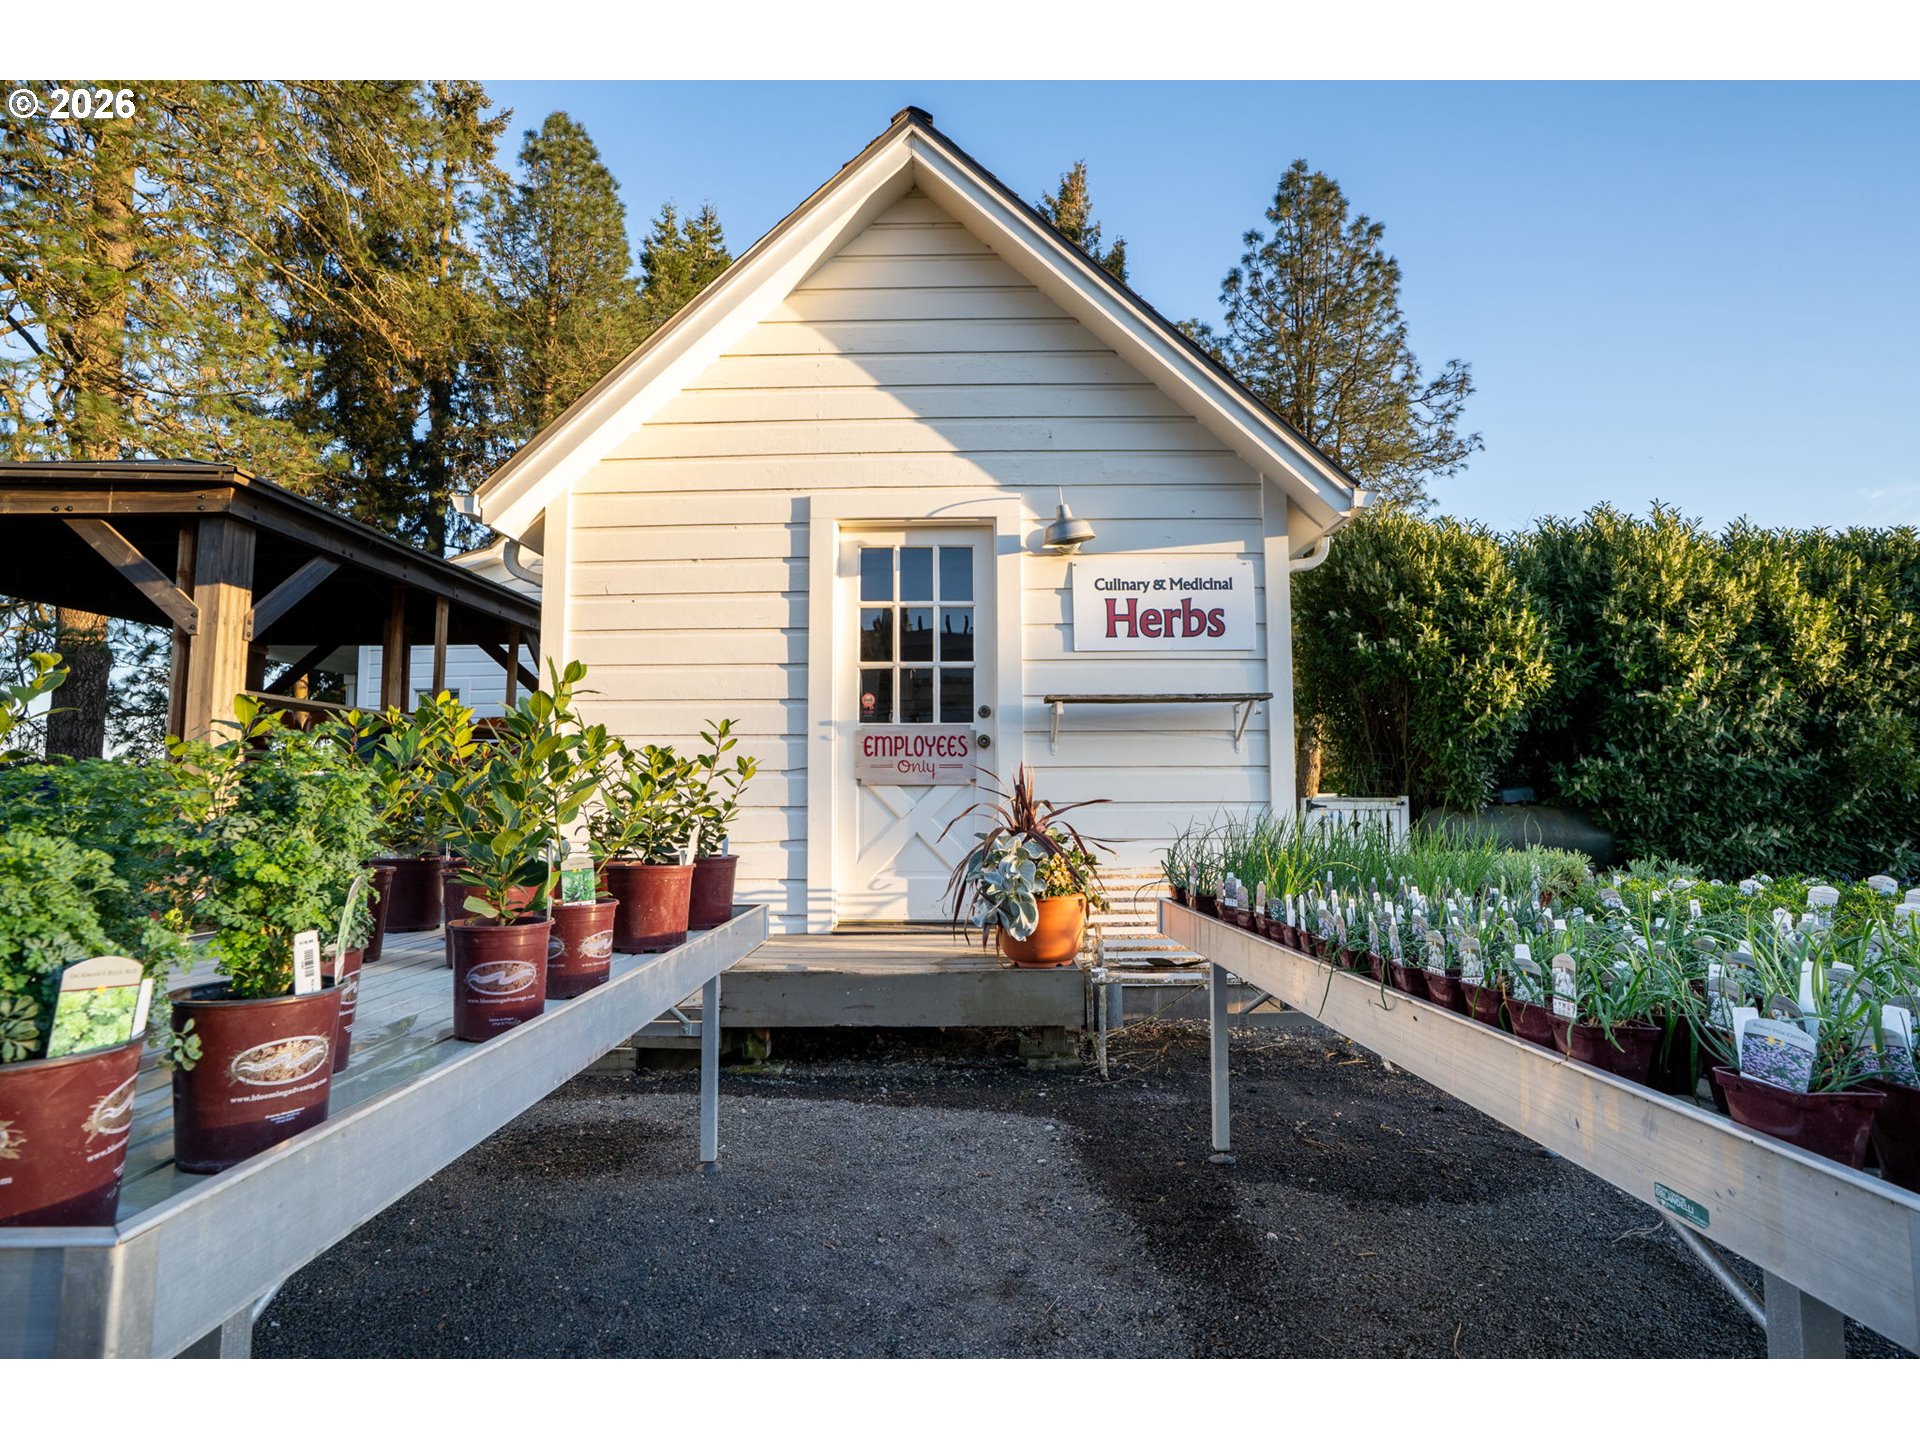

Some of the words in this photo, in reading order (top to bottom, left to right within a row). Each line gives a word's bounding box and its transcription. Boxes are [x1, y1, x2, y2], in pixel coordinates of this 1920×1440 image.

[1094, 577, 1149, 593] Culinary
[1152, 578, 1166, 591] &
[1169, 576, 1233, 591] Medicinal
[1104, 597, 1226, 639] Herbs
[863, 735, 968, 757] EMPLOYEES
[897, 759, 936, 779] Only
